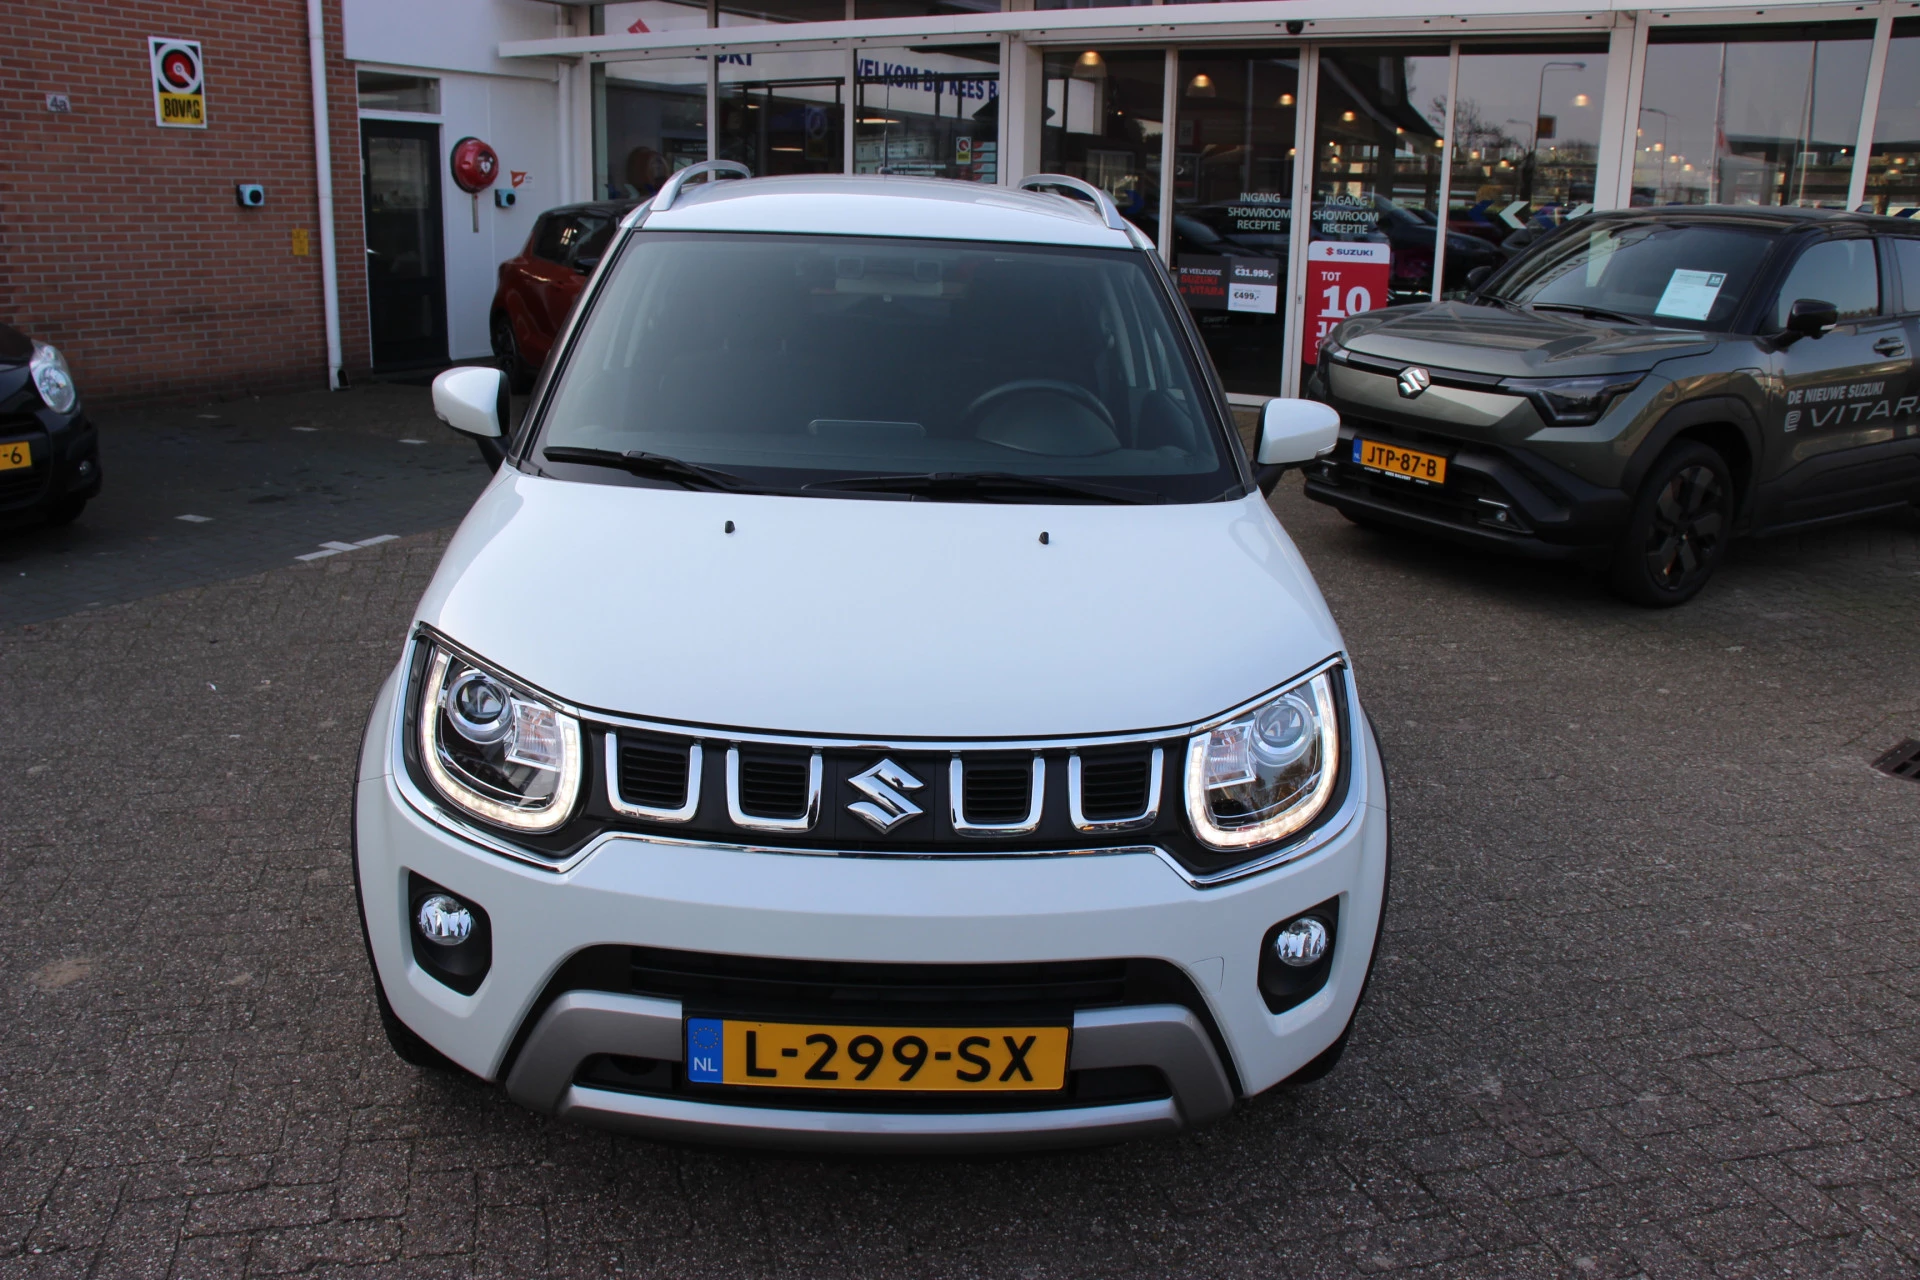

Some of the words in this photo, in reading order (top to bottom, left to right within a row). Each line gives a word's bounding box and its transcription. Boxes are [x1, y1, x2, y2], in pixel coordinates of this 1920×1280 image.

[989, 80, 999, 100] B
[164, 98, 200, 119] BOVAG
[1240, 193, 1281, 203] INGANG
[1325, 195, 1368, 206] INGANG
[1228, 207, 1291, 218] SHOWROOM
[1312, 211, 1379, 222] SHOWROOM
[1237, 220, 1281, 231] RECEPTIE
[1322, 223, 1368, 234] RECEPTIE
[1235, 268, 1274, 279] €31.995,-
[1321, 271, 1341, 282] TOT
[1190, 286, 1225, 296] VITARA
[1234, 291, 1260, 300] €499,-
[1321, 285, 1371, 318] 10
[1787, 389, 1804, 405] DE
[1804, 385, 1848, 403] NIEUWE
[1848, 381, 1885, 398] SUZUKI
[1811, 396, 1920, 427] VITAR
[1368, 446, 1437, 477] JTP-87-B
[746, 1030, 1036, 1083] L-299-SX
[693, 1056, 718, 1073] NL
